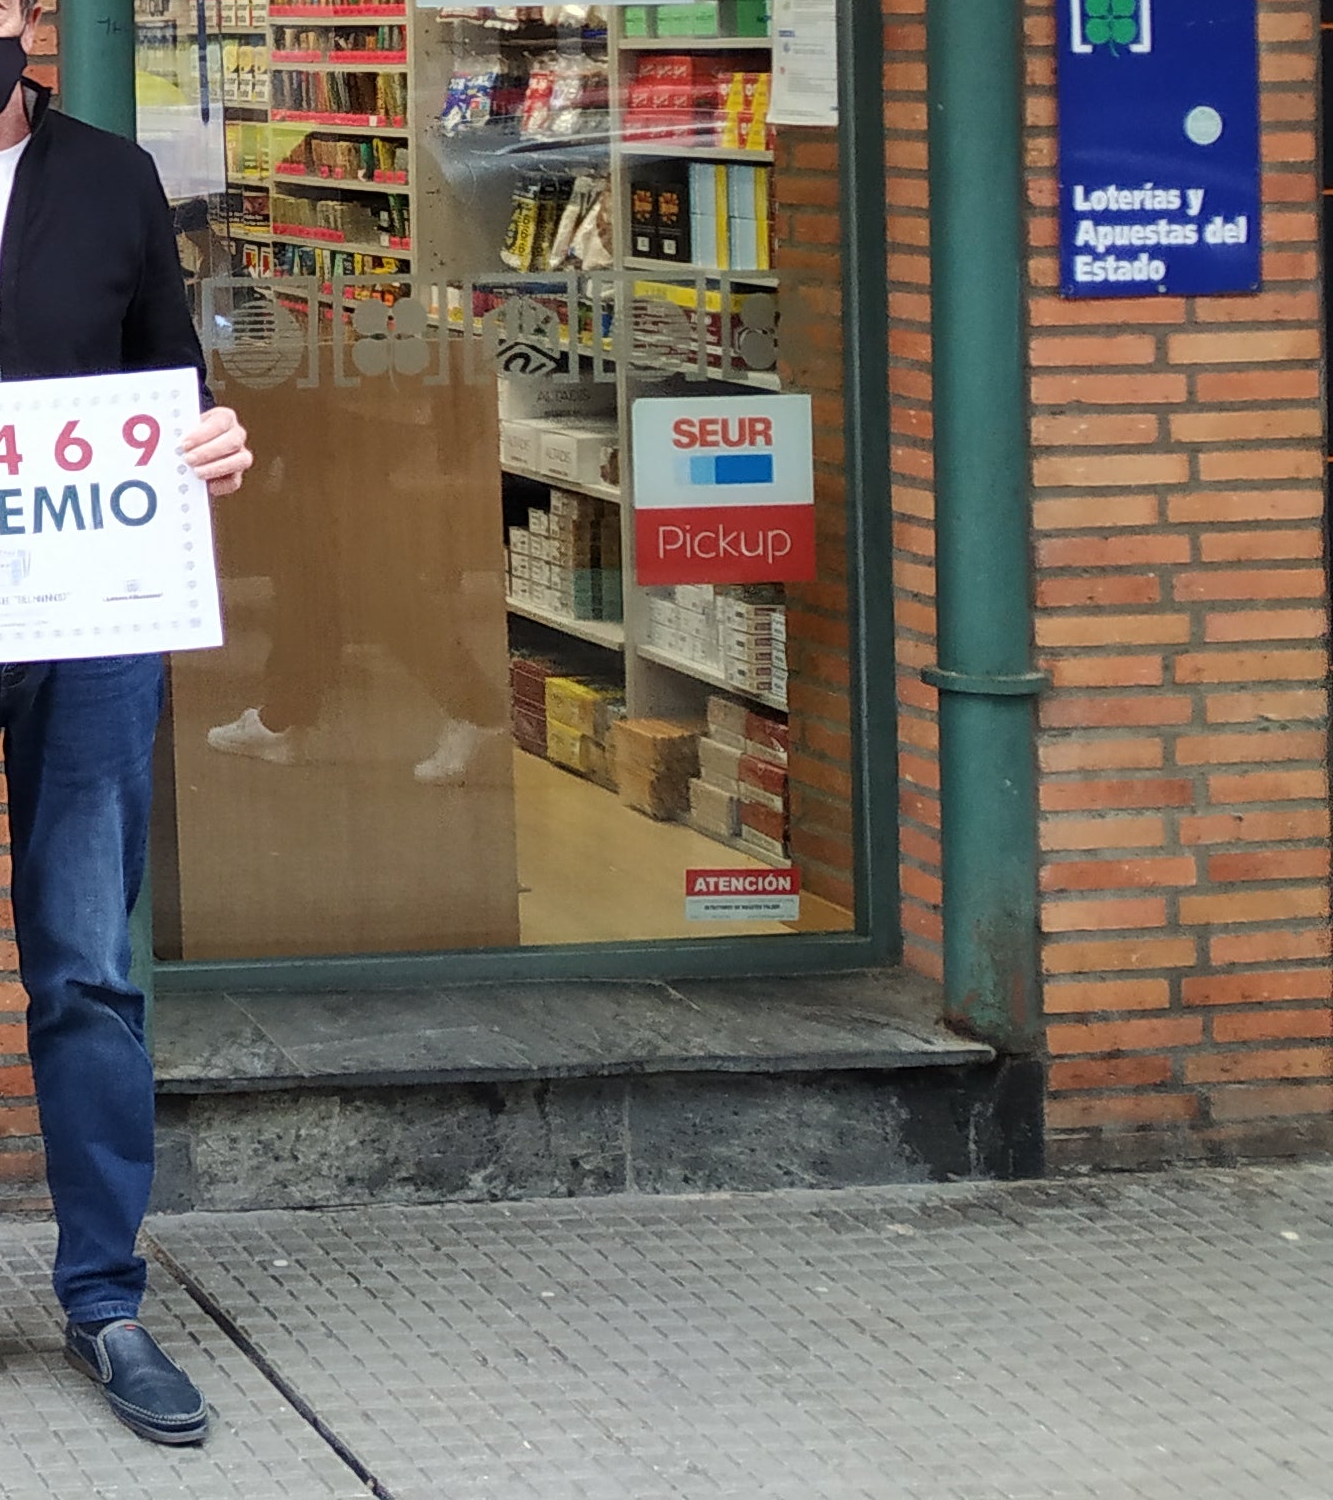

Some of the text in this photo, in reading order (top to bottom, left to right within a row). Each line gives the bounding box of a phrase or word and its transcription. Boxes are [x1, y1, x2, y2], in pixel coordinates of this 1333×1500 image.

[1073, 183, 1205, 216] Loterías y
[1074, 216, 1248, 252] Apuestas del
[1074, 253, 1166, 282] Estado
[672, 416, 773, 449] SEUR
[658, 523, 792, 564] Pickup
[694, 873, 792, 892] ATENCIÓN
